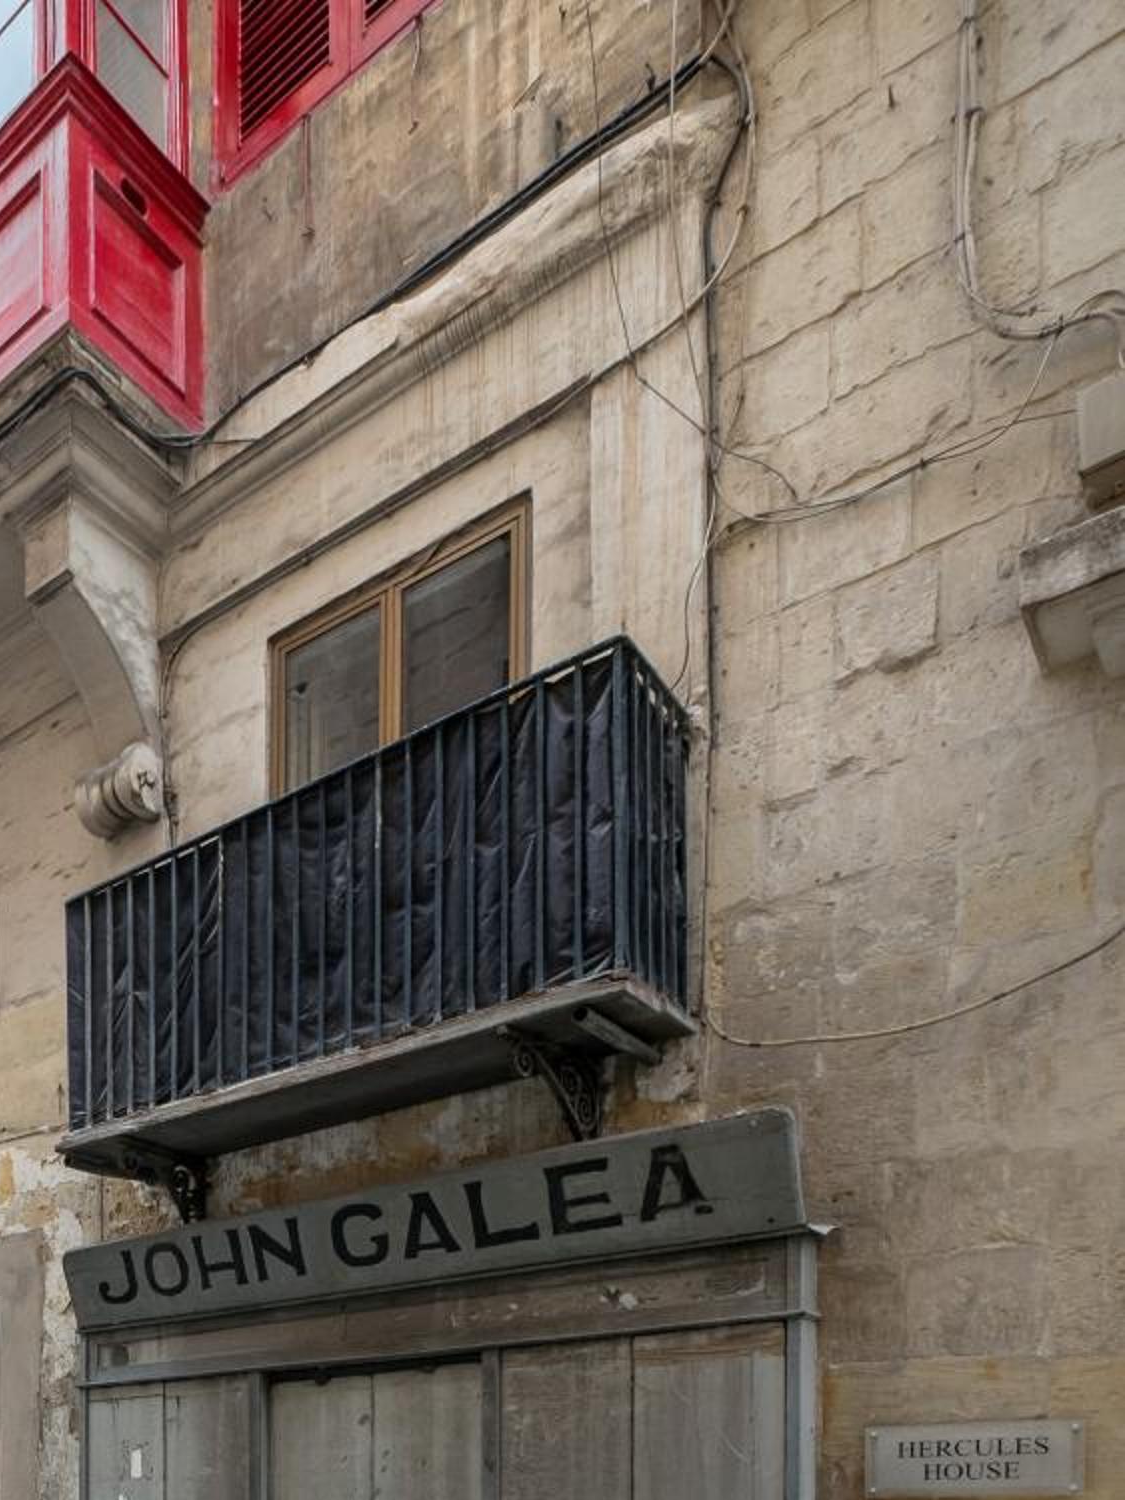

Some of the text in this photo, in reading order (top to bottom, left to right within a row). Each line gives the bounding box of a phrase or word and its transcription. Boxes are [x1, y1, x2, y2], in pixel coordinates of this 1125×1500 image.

[98, 1144, 713, 1304] JOHN GALEA
[897, 1436, 1049, 1459] HERCULES
[924, 1461, 1020, 1481] HOUSE
